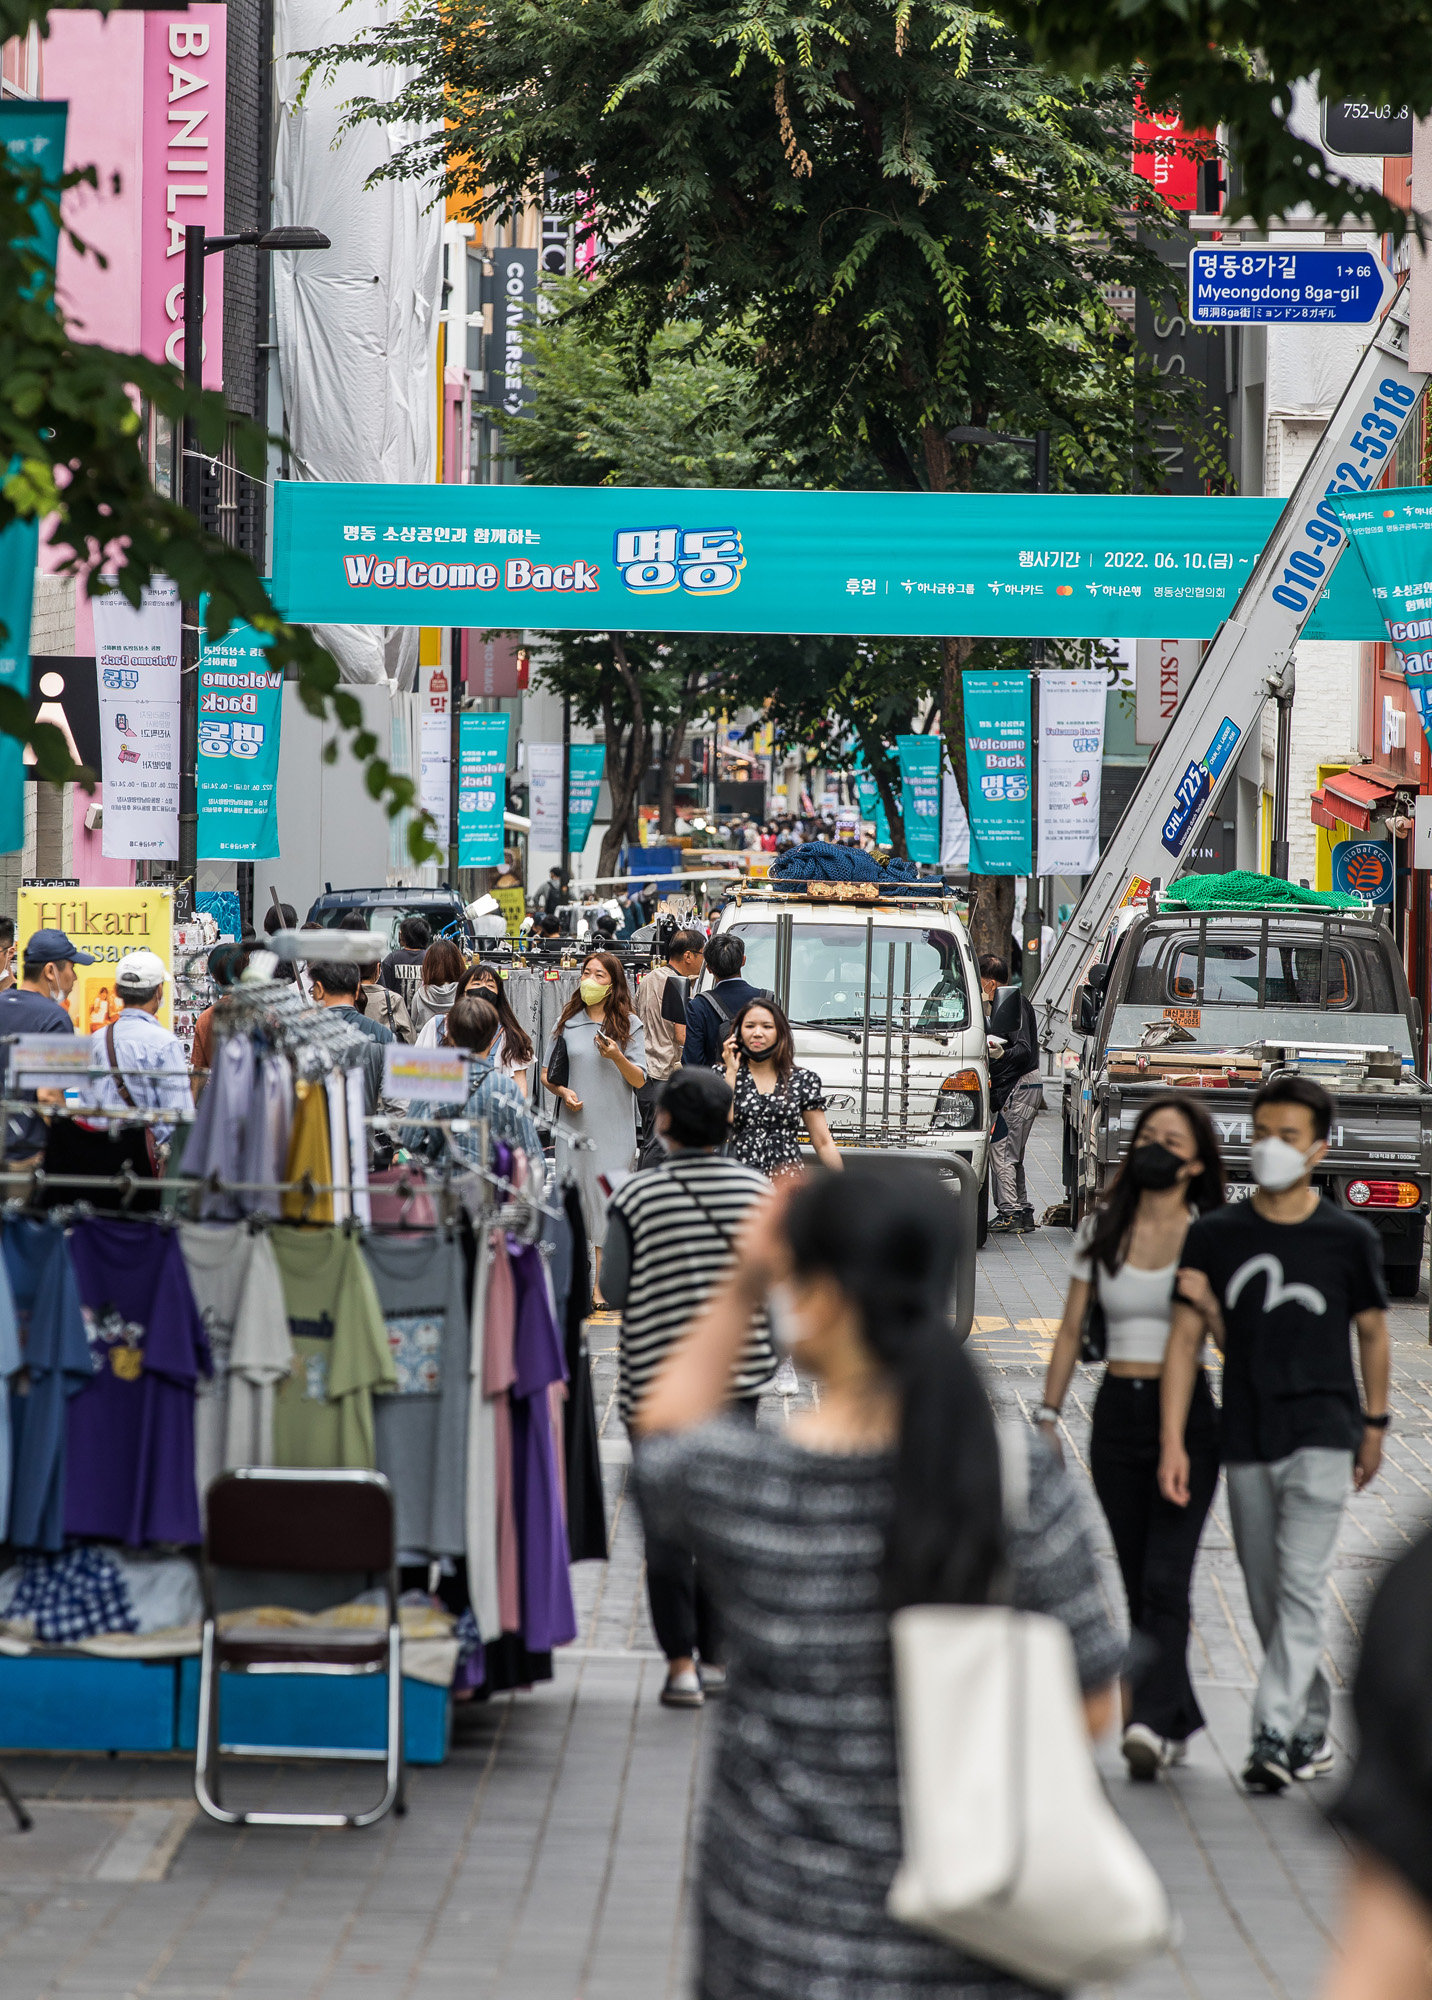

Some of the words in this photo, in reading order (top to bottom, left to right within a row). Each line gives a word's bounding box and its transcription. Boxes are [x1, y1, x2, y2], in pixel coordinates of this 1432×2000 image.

[166, 24, 210, 258] BANILA
[1198, 254, 1297, 279] 명동8가길
[1356, 265, 1371, 278] 66
[1198, 284, 1301, 303] Myeongdong
[1304, 284, 1360, 303] 8ga-gil
[1255, 308, 1337, 319] ミョンドン8ガギル
[505, 262, 525, 390] CONVERSE
[1271, 378, 1416, 613] 010-9052-5318
[343, 525, 377, 543] 명동
[382, 526, 468, 544] 소상공인과
[473, 528, 542, 545] 함께하는
[613, 524, 748, 597] 명동
[1018, 550, 1081, 569] 행사기간
[1104, 551, 1149, 569] 2022.
[1154, 552, 1179, 569] 06.
[1184, 552, 1234, 571] 10.(금)
[343, 554, 499, 592] Welcome
[506, 557, 600, 593] Back
[845, 578, 877, 596] 후원
[917, 581, 976, 596] 하나금융그룹
[1004, 583, 1044, 597] 하나카드
[1102, 584, 1142, 598] 하나은행
[1153, 585, 1226, 599] 명동상인협의회
[1395, 650, 1432, 676] Bac
[1160, 656, 1179, 718] SKIN
[968, 737, 1026, 751] Welcome
[986, 754, 1026, 769] Back
[980, 772, 1029, 801] 명동
[1188, 847, 1213, 859] KIN
[1343, 844, 1372, 863] global
[1373, 848, 1387, 863] eco
[33, 901, 151, 936] Hikari
